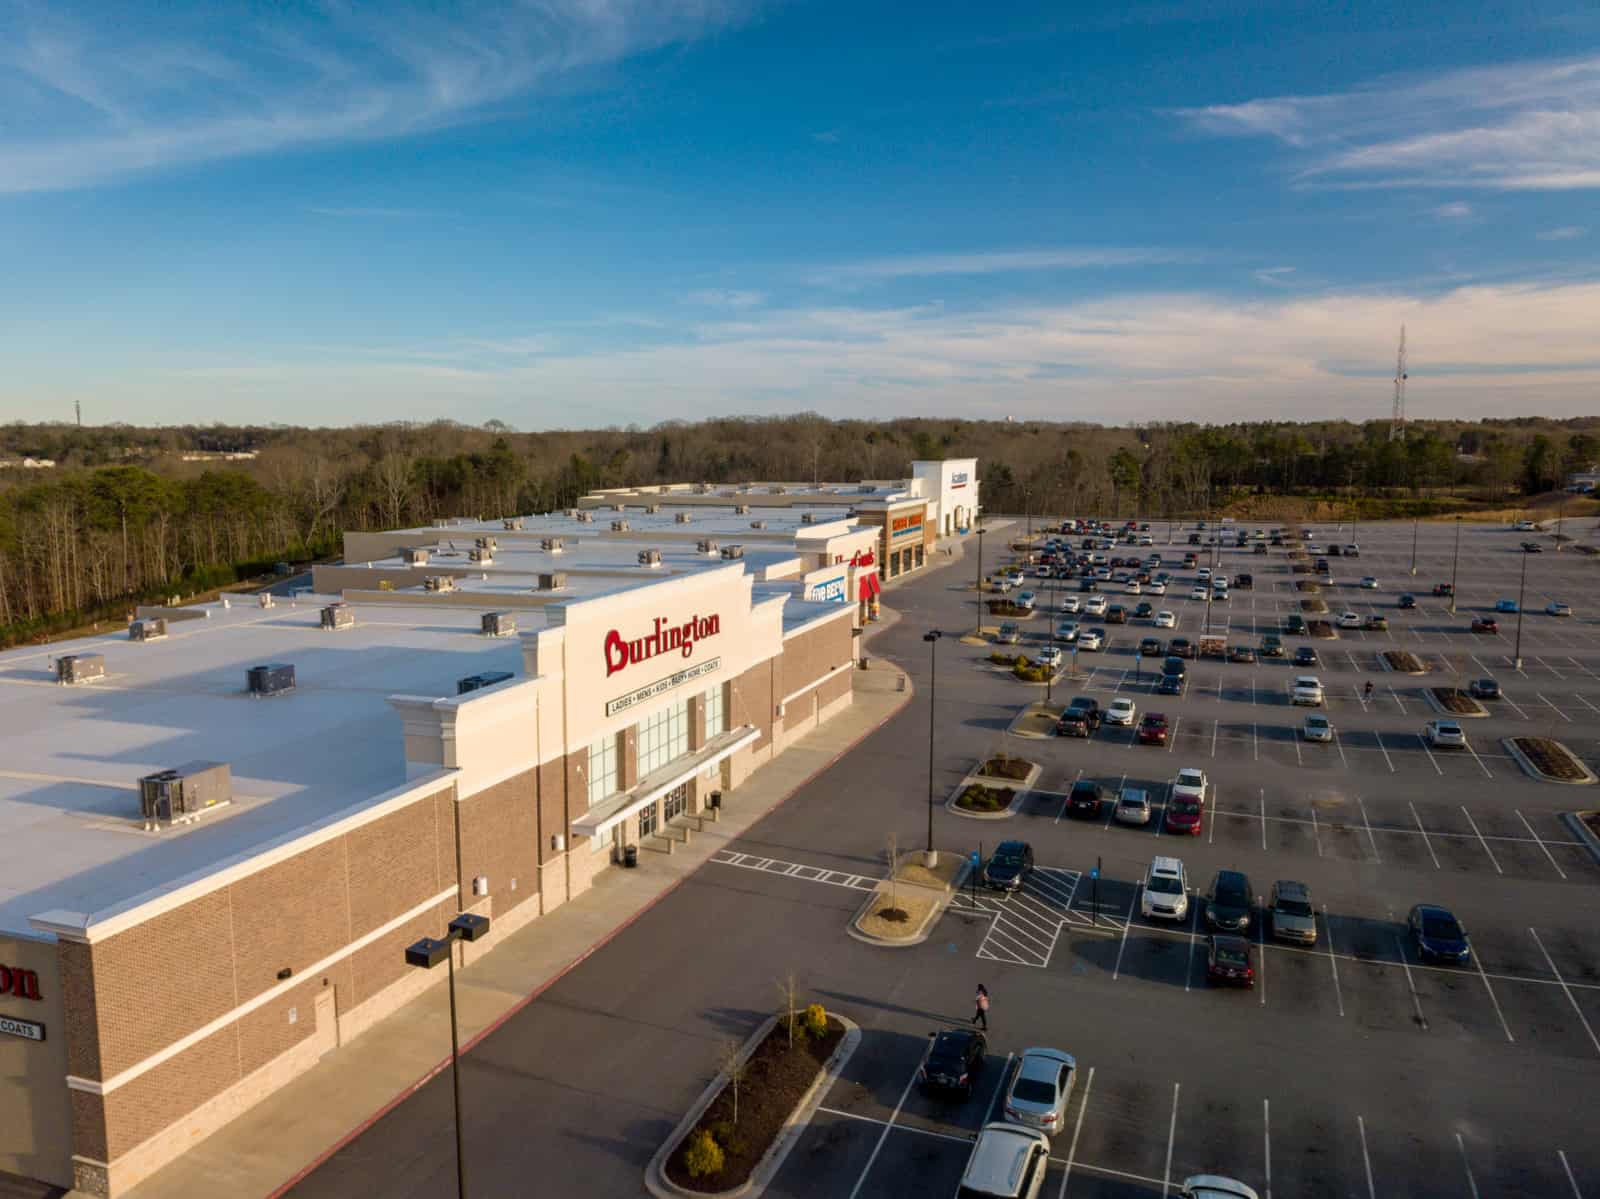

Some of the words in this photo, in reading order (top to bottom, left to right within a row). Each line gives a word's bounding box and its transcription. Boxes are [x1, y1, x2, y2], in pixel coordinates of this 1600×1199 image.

[604, 614, 720, 678] Burlington
[611, 696, 632, 712] LADIES
[636, 687, 652, 701] MENS
[656, 680, 668, 692] KIDS
[1, 1020, 34, 1036] COATS
